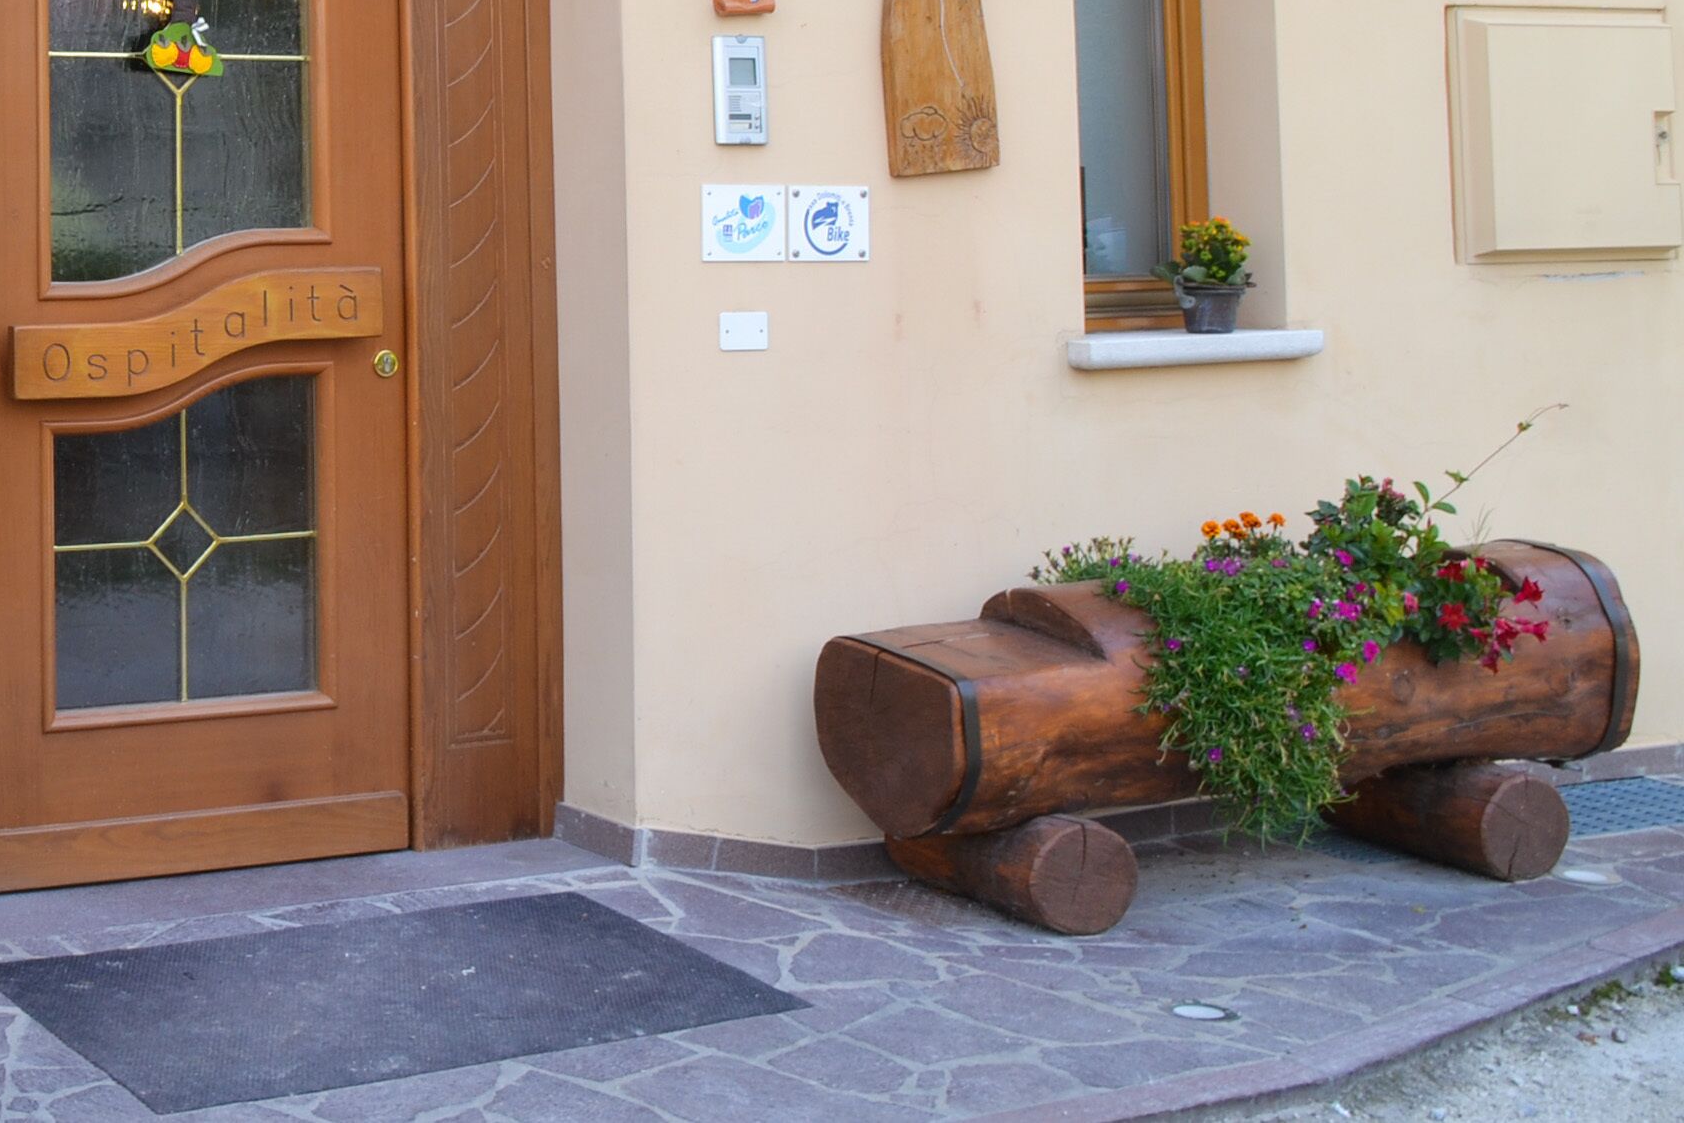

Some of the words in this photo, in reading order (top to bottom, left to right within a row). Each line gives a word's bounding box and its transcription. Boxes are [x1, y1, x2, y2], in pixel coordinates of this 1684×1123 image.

[736, 220, 770, 241] Parco
[826, 225, 851, 243] Bike
[41, 283, 359, 387] Ospitalità
